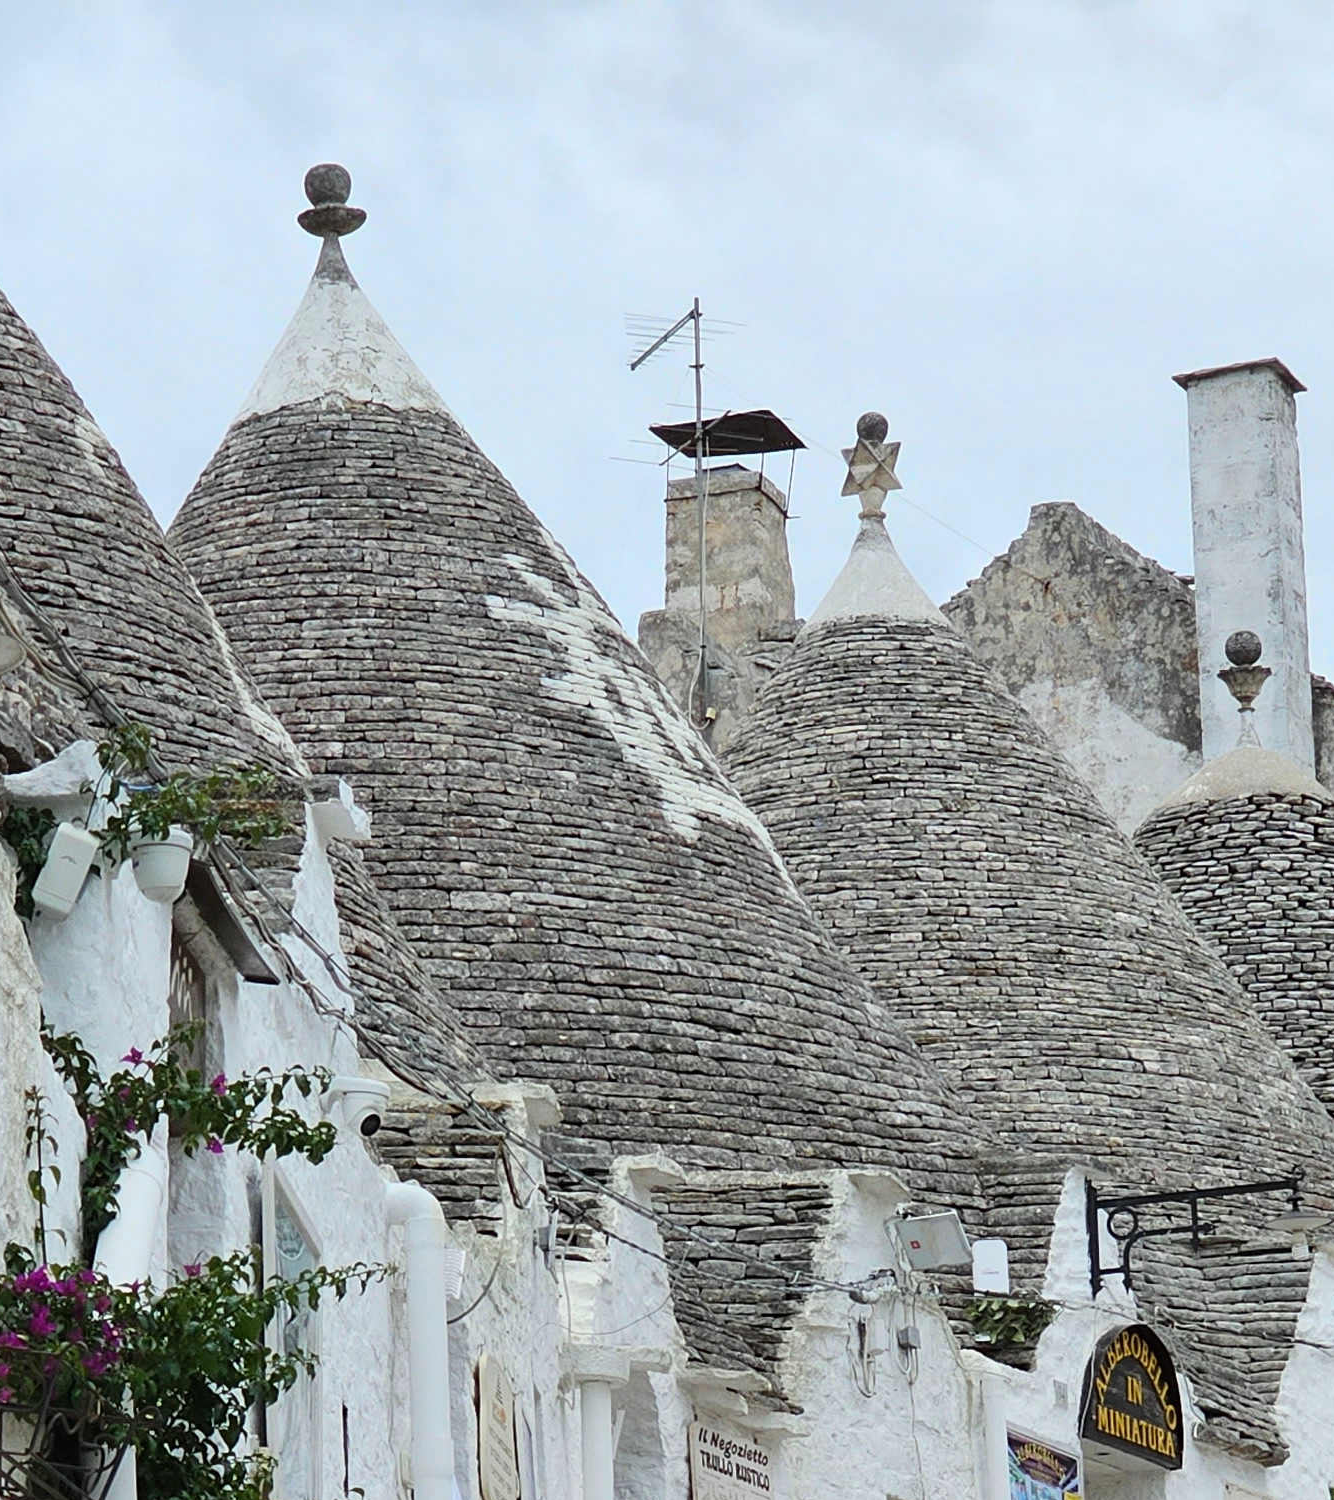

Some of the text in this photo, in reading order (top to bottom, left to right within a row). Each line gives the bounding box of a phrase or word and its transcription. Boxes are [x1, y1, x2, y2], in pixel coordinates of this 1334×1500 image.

[1095, 1331, 1177, 1431] ALBEROBELLO
[1126, 1376, 1143, 1406] IN
[710, 1431, 769, 1467] Negozietto
[1097, 1404, 1176, 1458] MINIATURA
[700, 1449, 770, 1491] TRULLO RUSTICO
